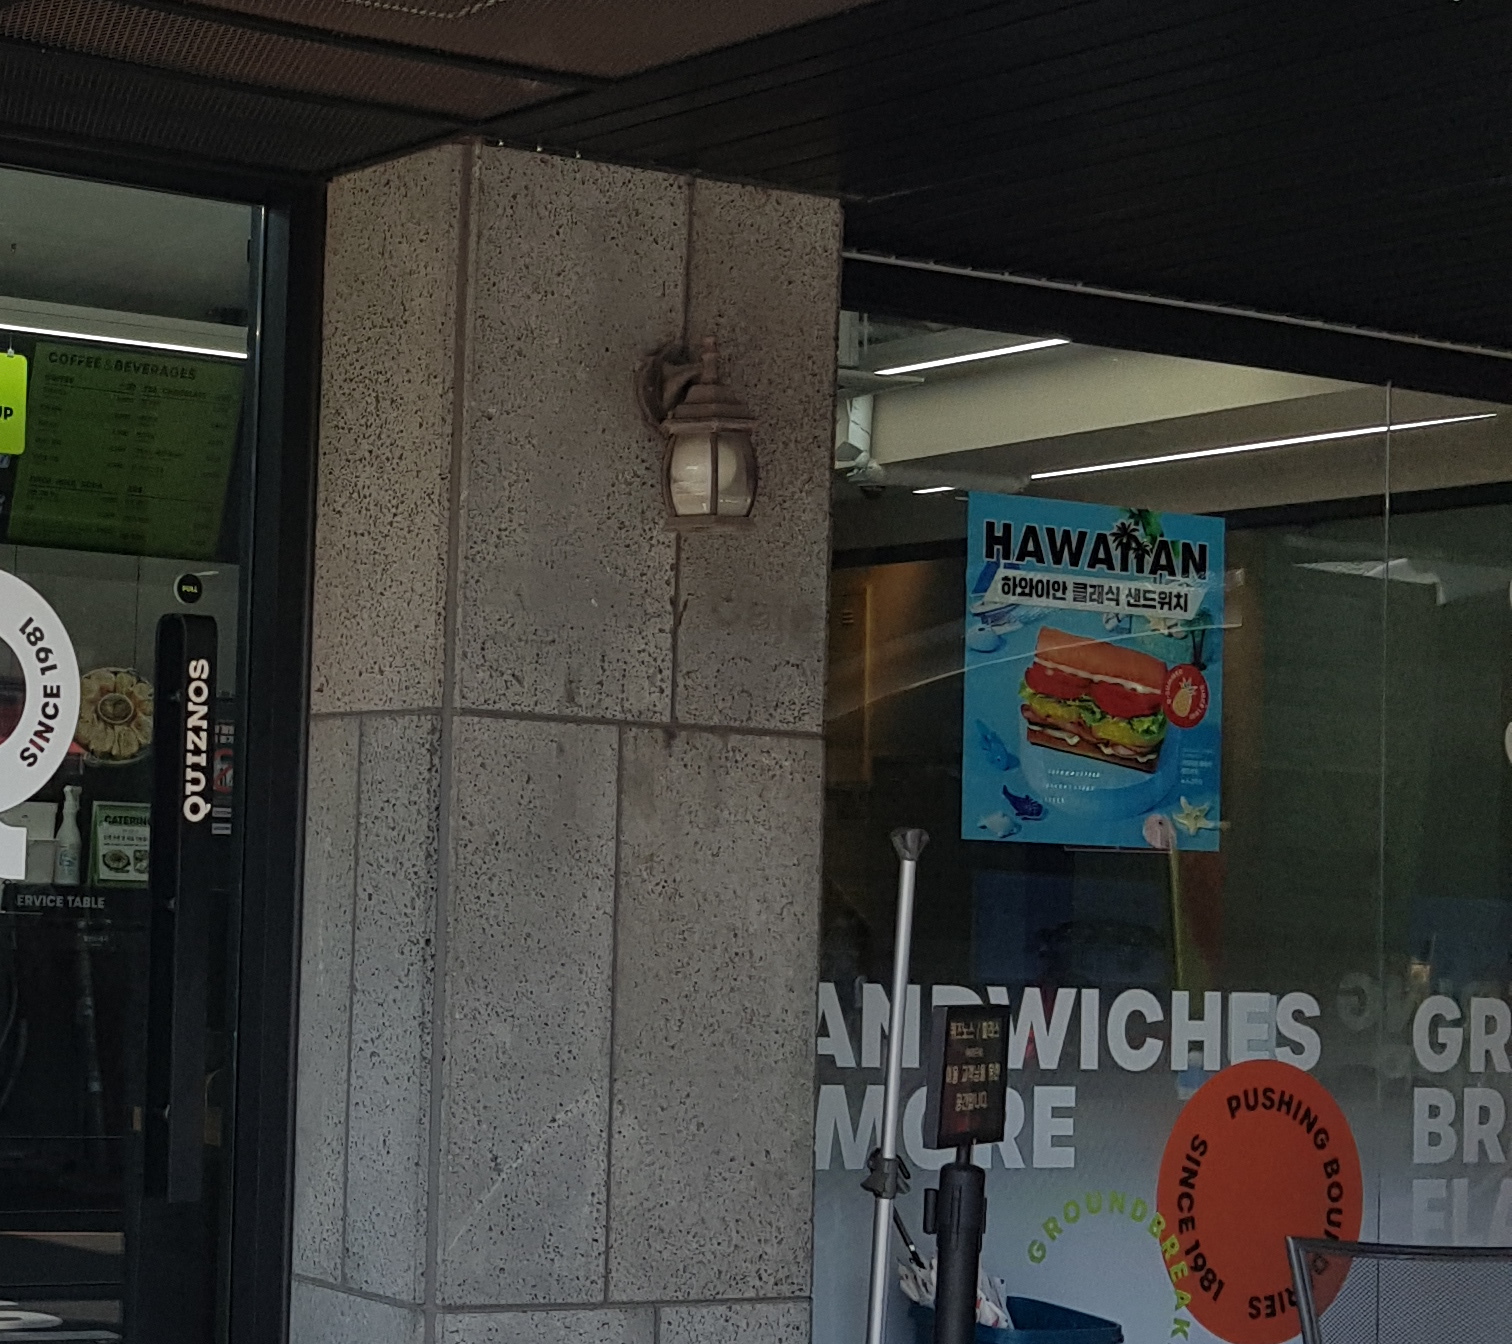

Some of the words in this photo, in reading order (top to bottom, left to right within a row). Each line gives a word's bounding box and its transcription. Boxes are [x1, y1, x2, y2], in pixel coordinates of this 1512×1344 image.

[48, 351, 102, 369] COFFEE
[114, 358, 197, 381] BEVERAGES
[1001, 574, 1068, 602] 하와이안
[1072, 581, 1121, 608] 클래식
[1126, 588, 1189, 613] 샌드위치
[18, 617, 61, 676] 1981
[19, 683, 61, 768] SINCE
[183, 658, 212, 823] QUIZNOS
[104, 814, 149, 826] CATERIN
[67, 895, 106, 909] TABLE
[1226, 1087, 1330, 1152] PUSHING
[1176, 1134, 1209, 1236] SINCE
[1185, 1240, 1226, 1302] 1981
